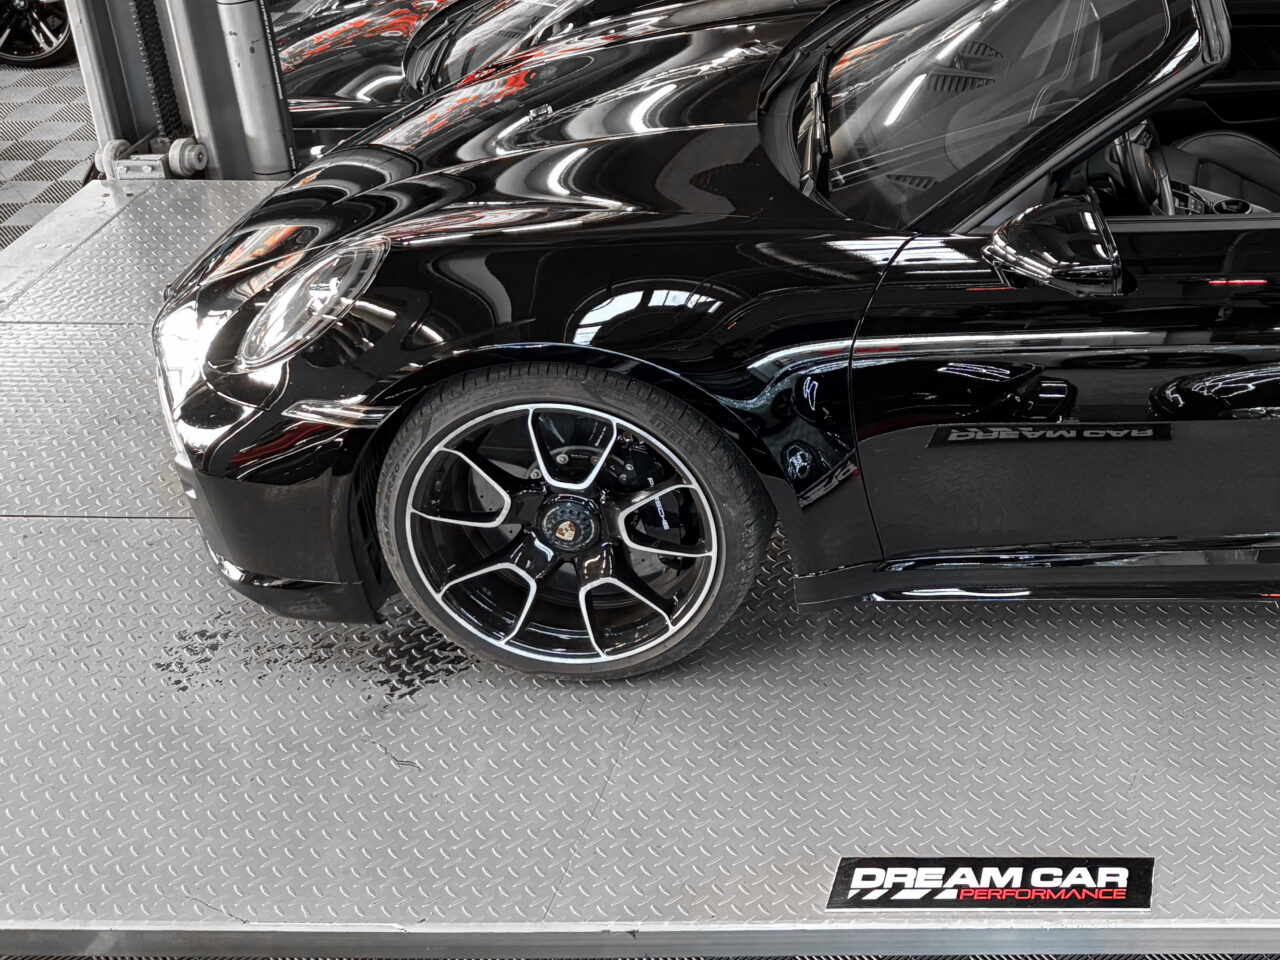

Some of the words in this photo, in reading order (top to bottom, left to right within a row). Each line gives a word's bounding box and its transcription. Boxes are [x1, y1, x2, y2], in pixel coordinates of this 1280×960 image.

[850, 867, 1022, 888] DREAM
[1030, 867, 1129, 889] CAR
[959, 888, 1127, 900] PERFORMANCE
